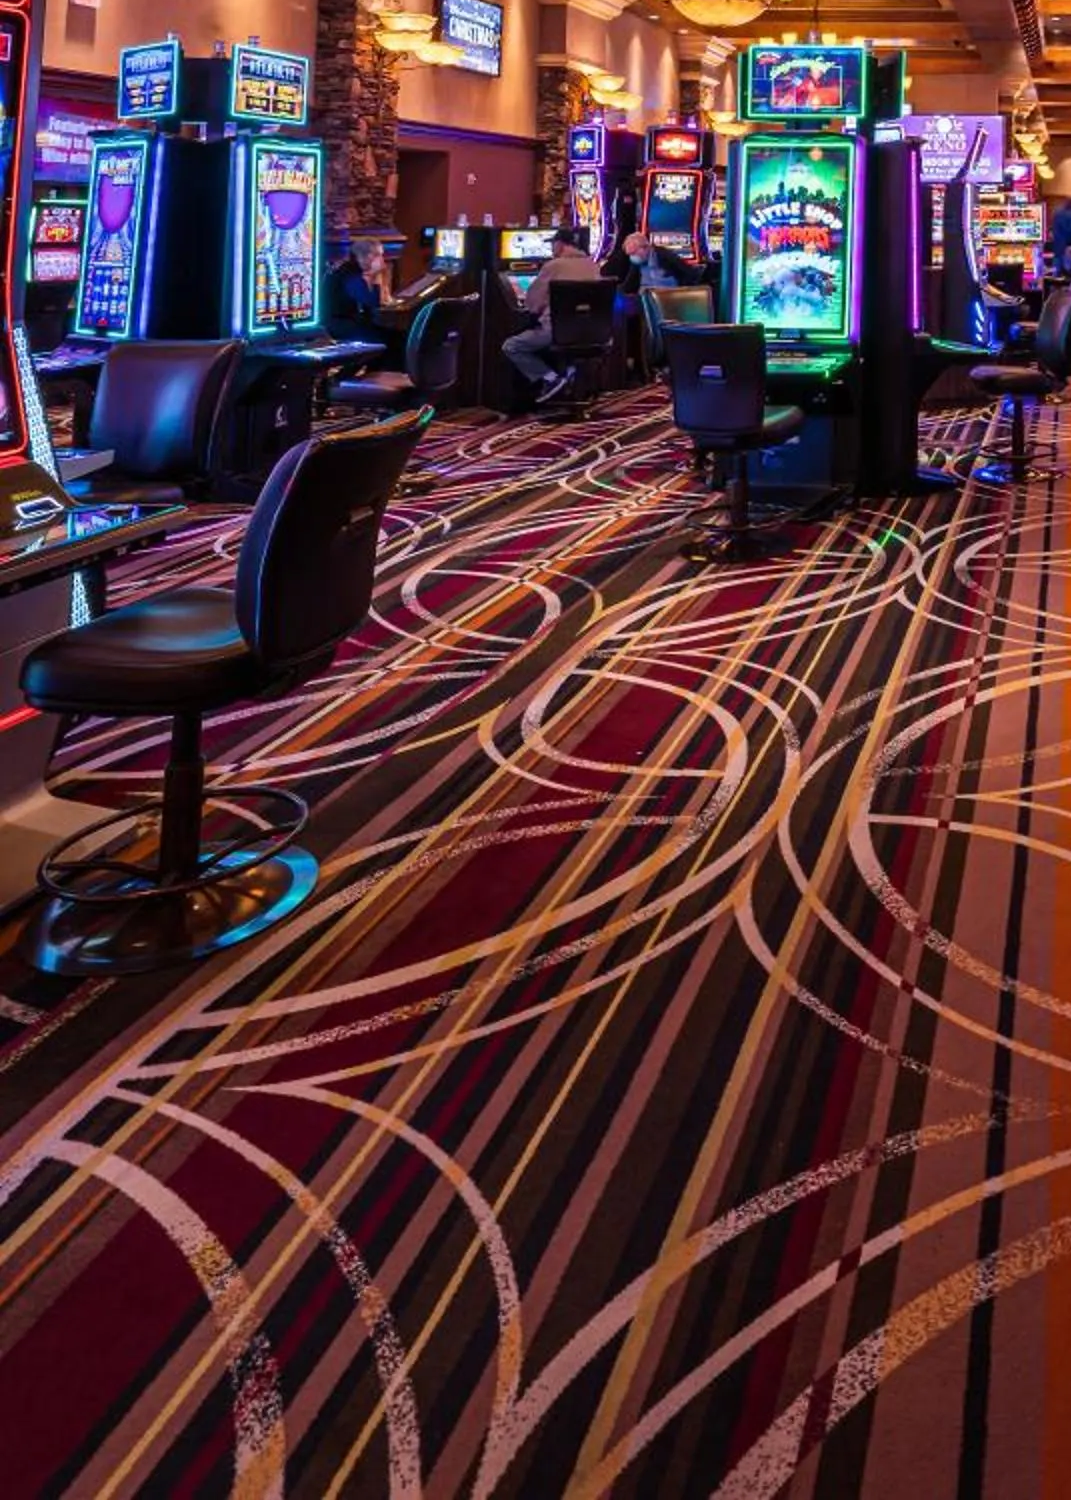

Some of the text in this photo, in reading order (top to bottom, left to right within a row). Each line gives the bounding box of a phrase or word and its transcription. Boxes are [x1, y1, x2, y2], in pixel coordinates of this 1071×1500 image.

[921, 139, 967, 151] KENO
[750, 202, 843, 230] LITTLE SHOP
[759, 225, 831, 252] HORRORS
